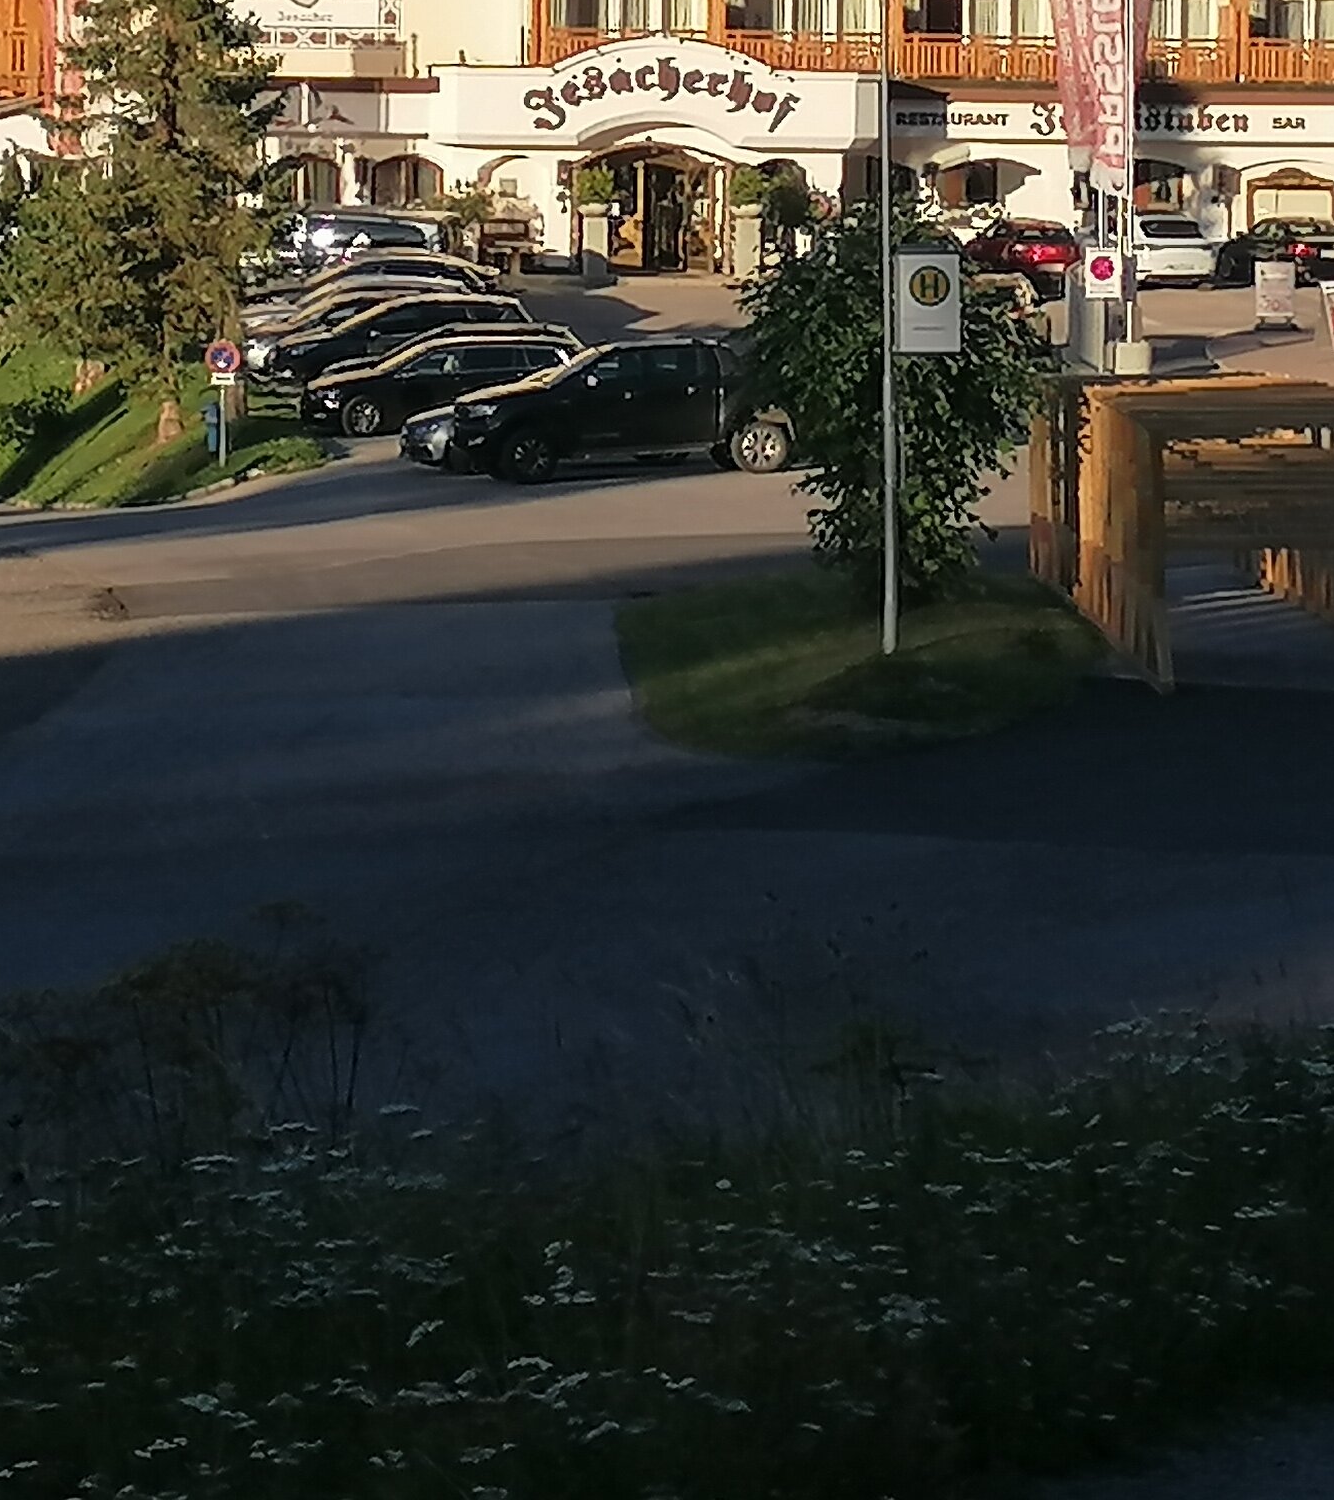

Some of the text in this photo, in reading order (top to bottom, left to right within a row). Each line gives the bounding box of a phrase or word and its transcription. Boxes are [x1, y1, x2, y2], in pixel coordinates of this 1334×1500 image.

[523, 57, 801, 133] Jesacherhof
[895, 111, 1010, 128] RESTAURANT
[920, 271, 939, 299] H
